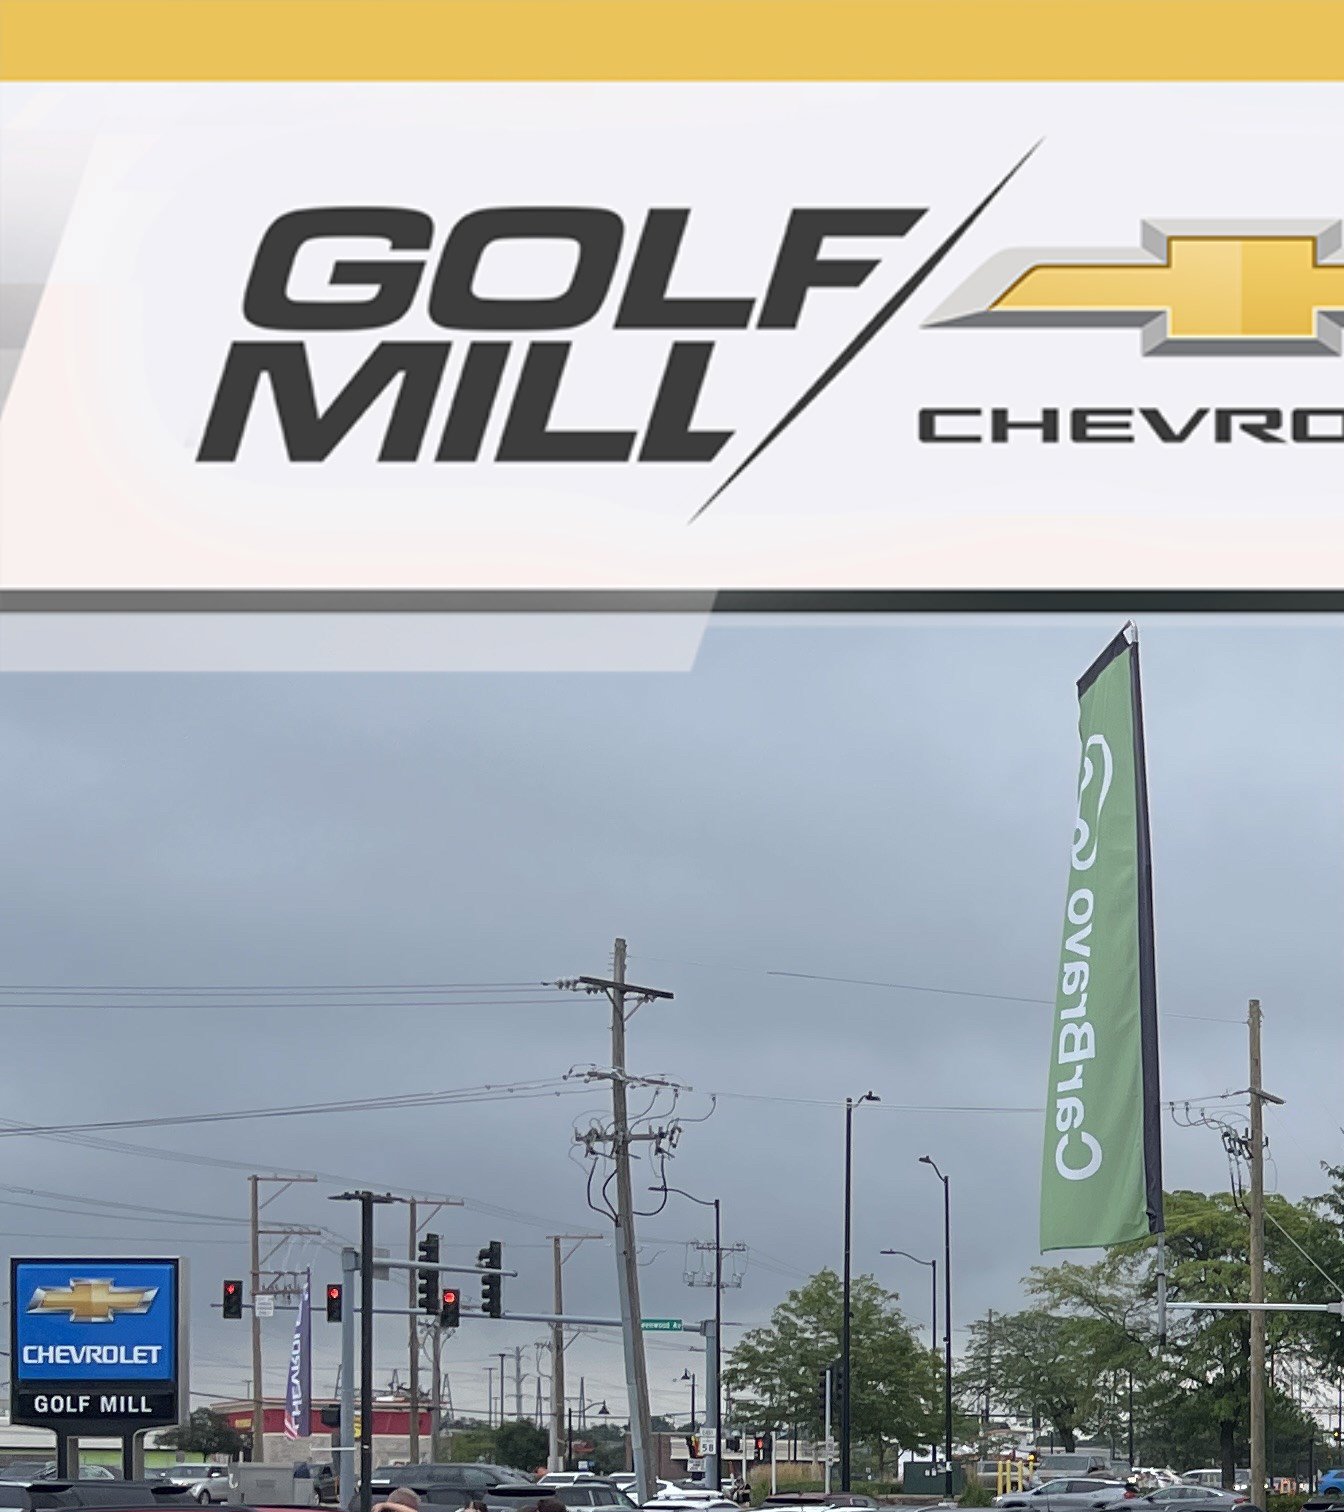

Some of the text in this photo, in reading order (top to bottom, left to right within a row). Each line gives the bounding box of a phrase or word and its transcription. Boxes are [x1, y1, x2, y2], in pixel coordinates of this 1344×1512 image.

[22, 1345, 162, 1364] CHEVROLET
[34, 1395, 152, 1413] GOLF MILL
